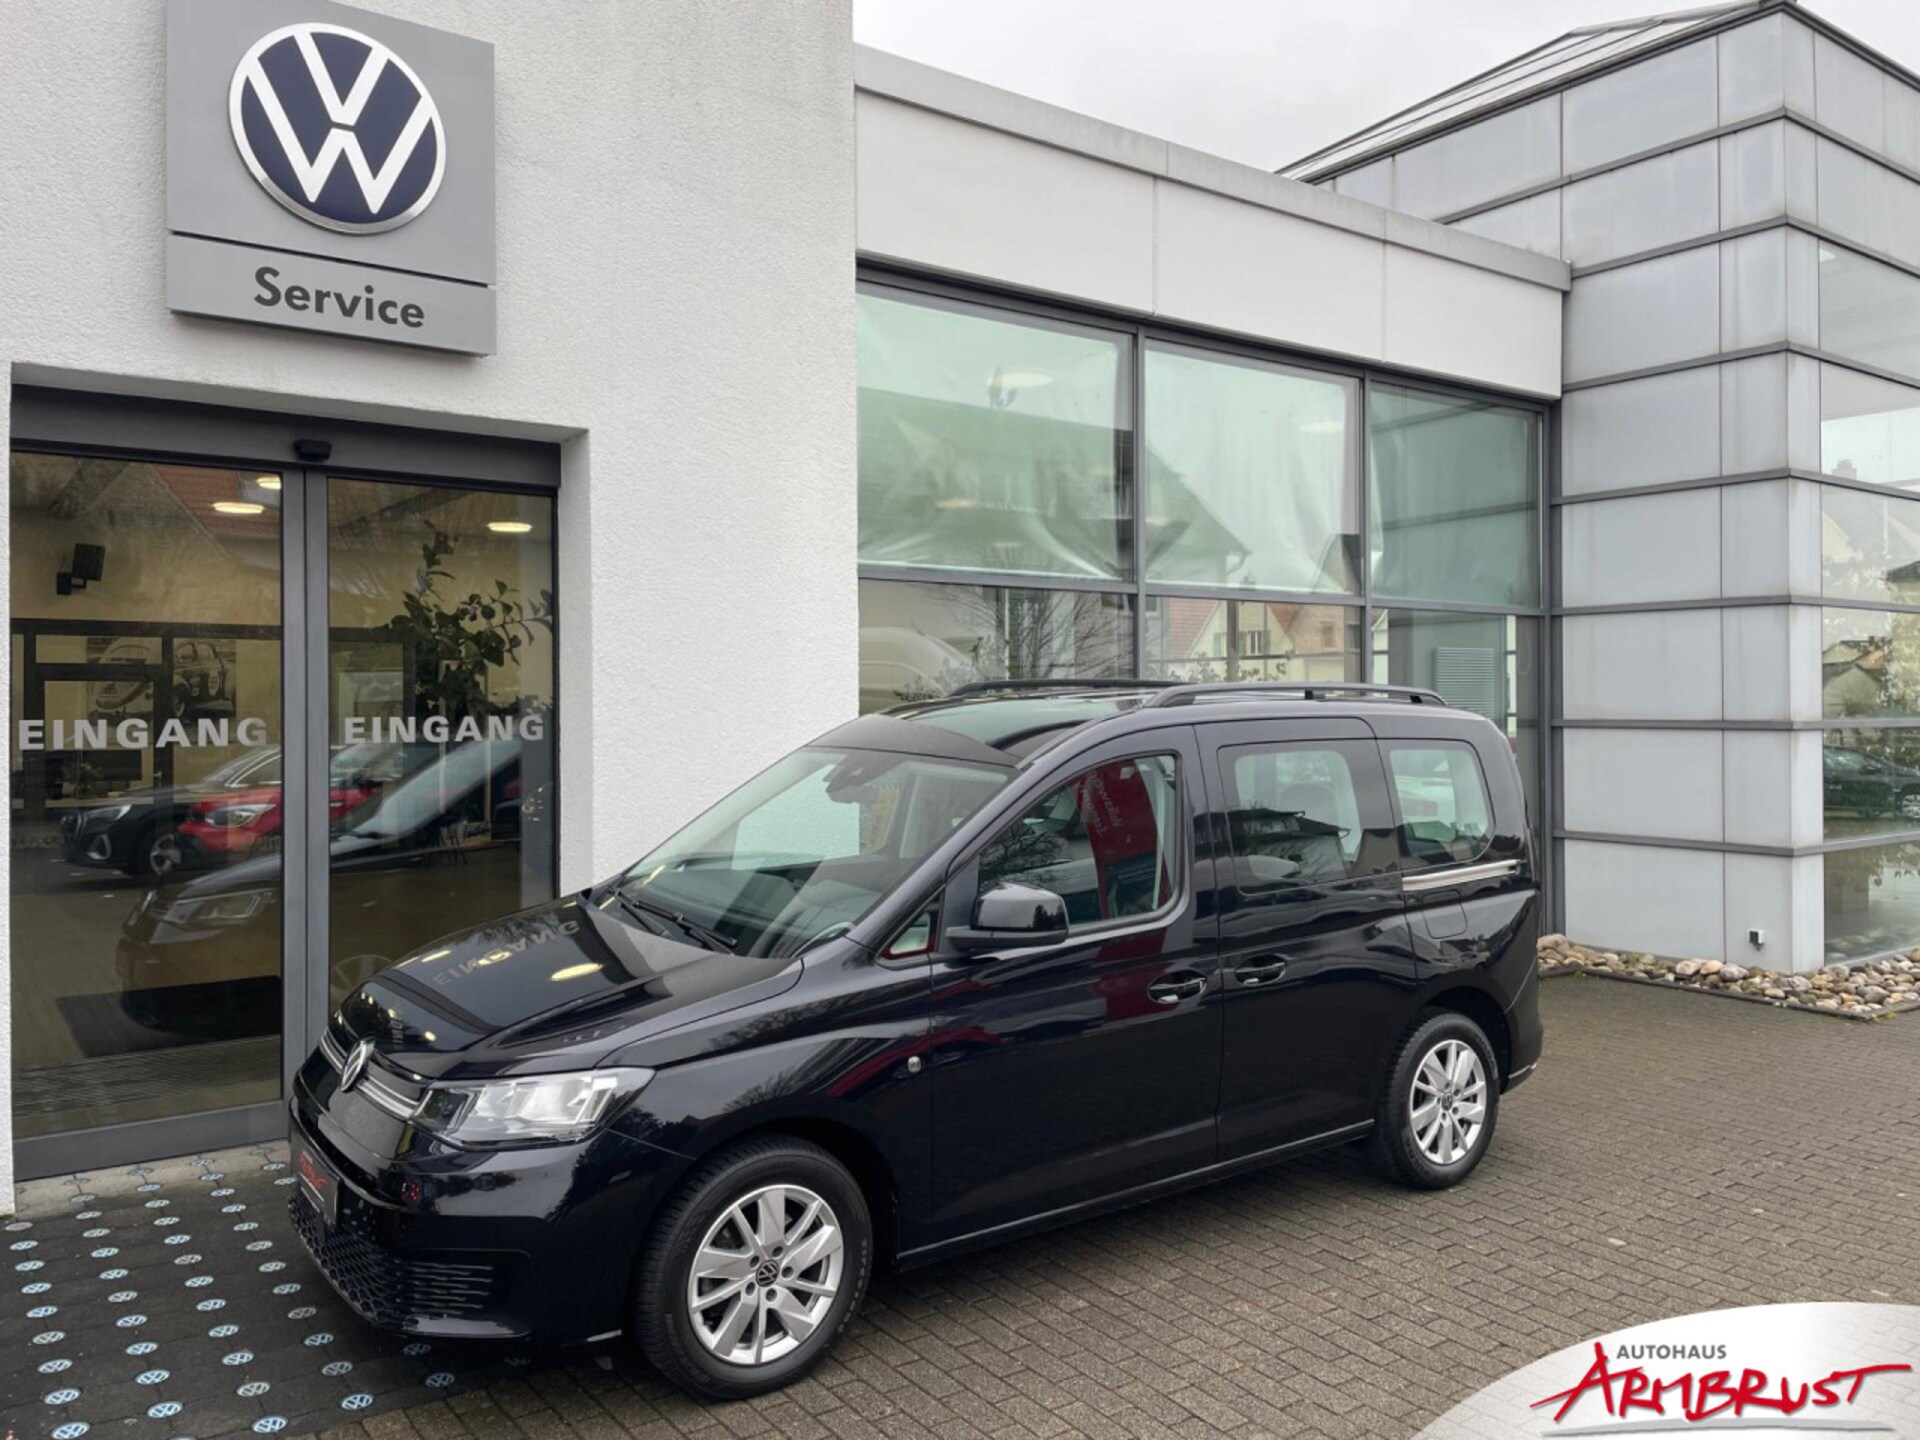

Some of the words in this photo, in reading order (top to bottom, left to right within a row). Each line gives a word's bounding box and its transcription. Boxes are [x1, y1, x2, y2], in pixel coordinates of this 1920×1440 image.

[254, 266, 425, 328] Service
[18, 717, 267, 751] EINGANG
[344, 715, 544, 744] EINGANG
